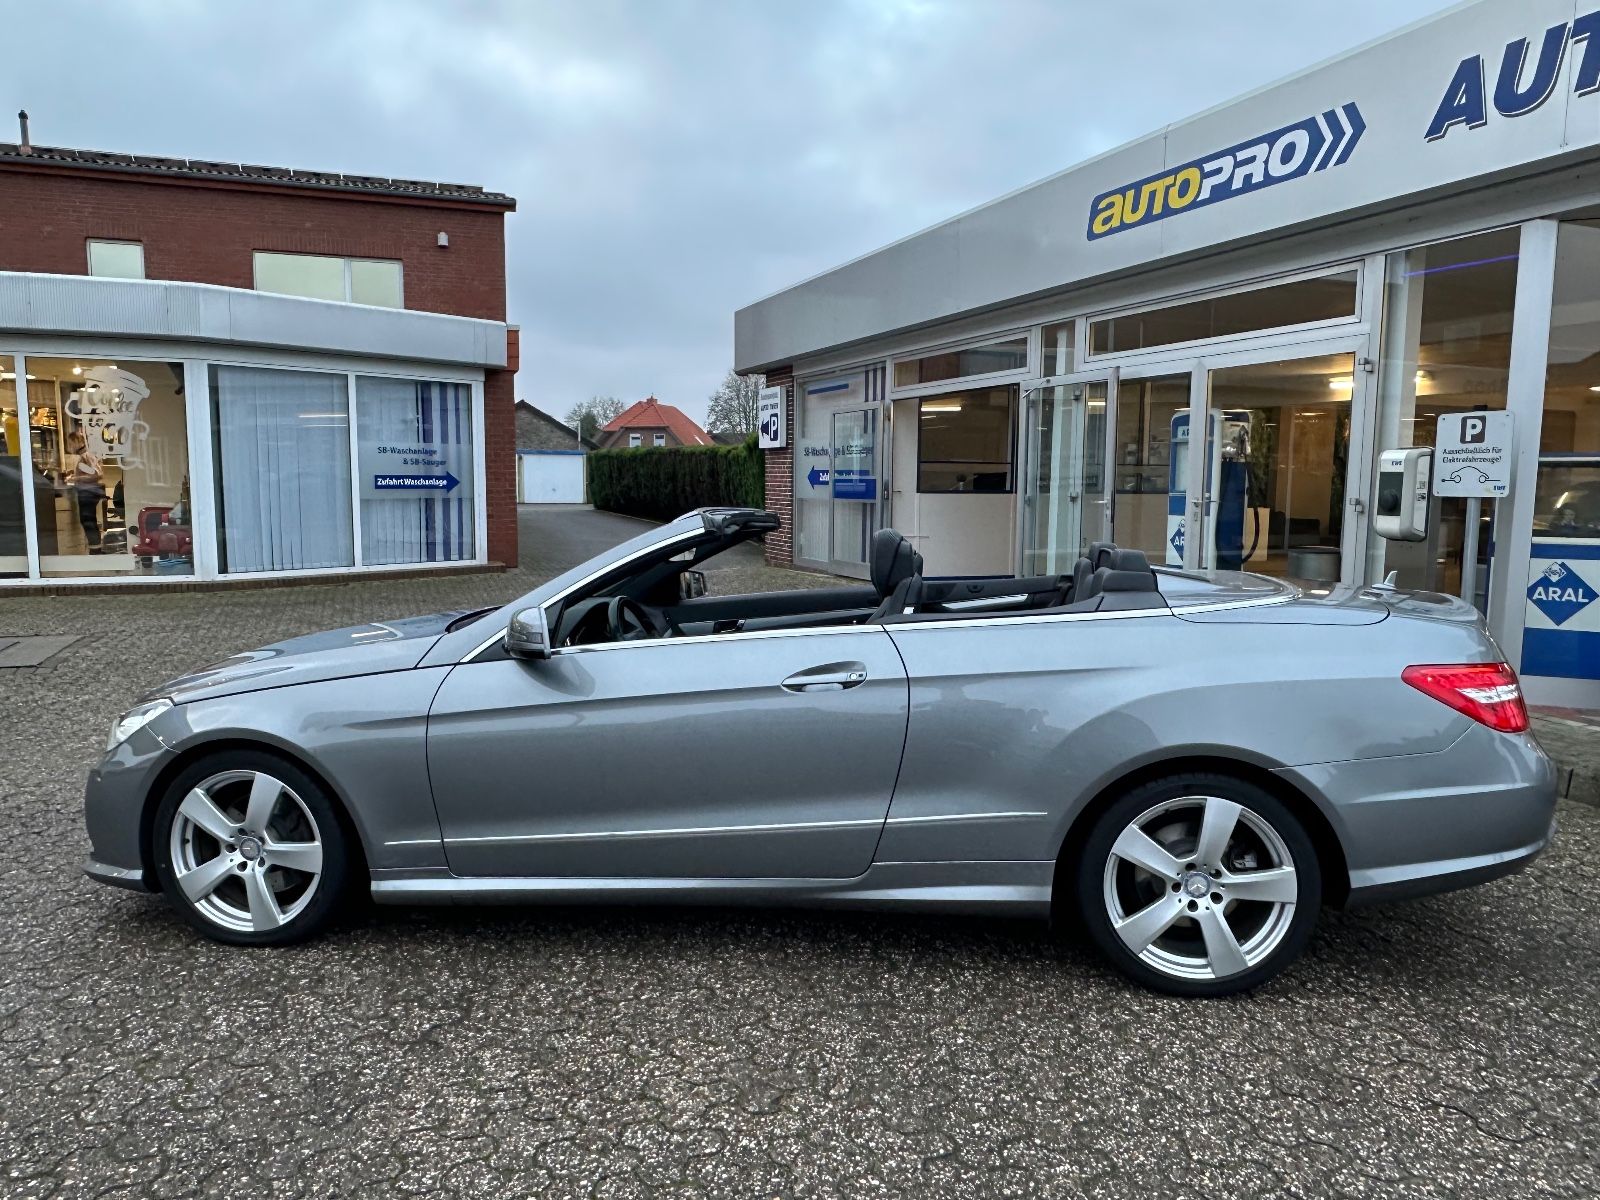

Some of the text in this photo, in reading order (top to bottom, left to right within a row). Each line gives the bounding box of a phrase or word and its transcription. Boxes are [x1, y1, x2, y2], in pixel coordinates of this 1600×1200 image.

[1465, 418, 1483, 442] P
[377, 446, 438, 456] SB-Waschanlage
[1491, 446, 1502, 454] für
[377, 478, 448, 487] Zufahrt Waschanlage
[1532, 586, 1590, 602] ARAL
